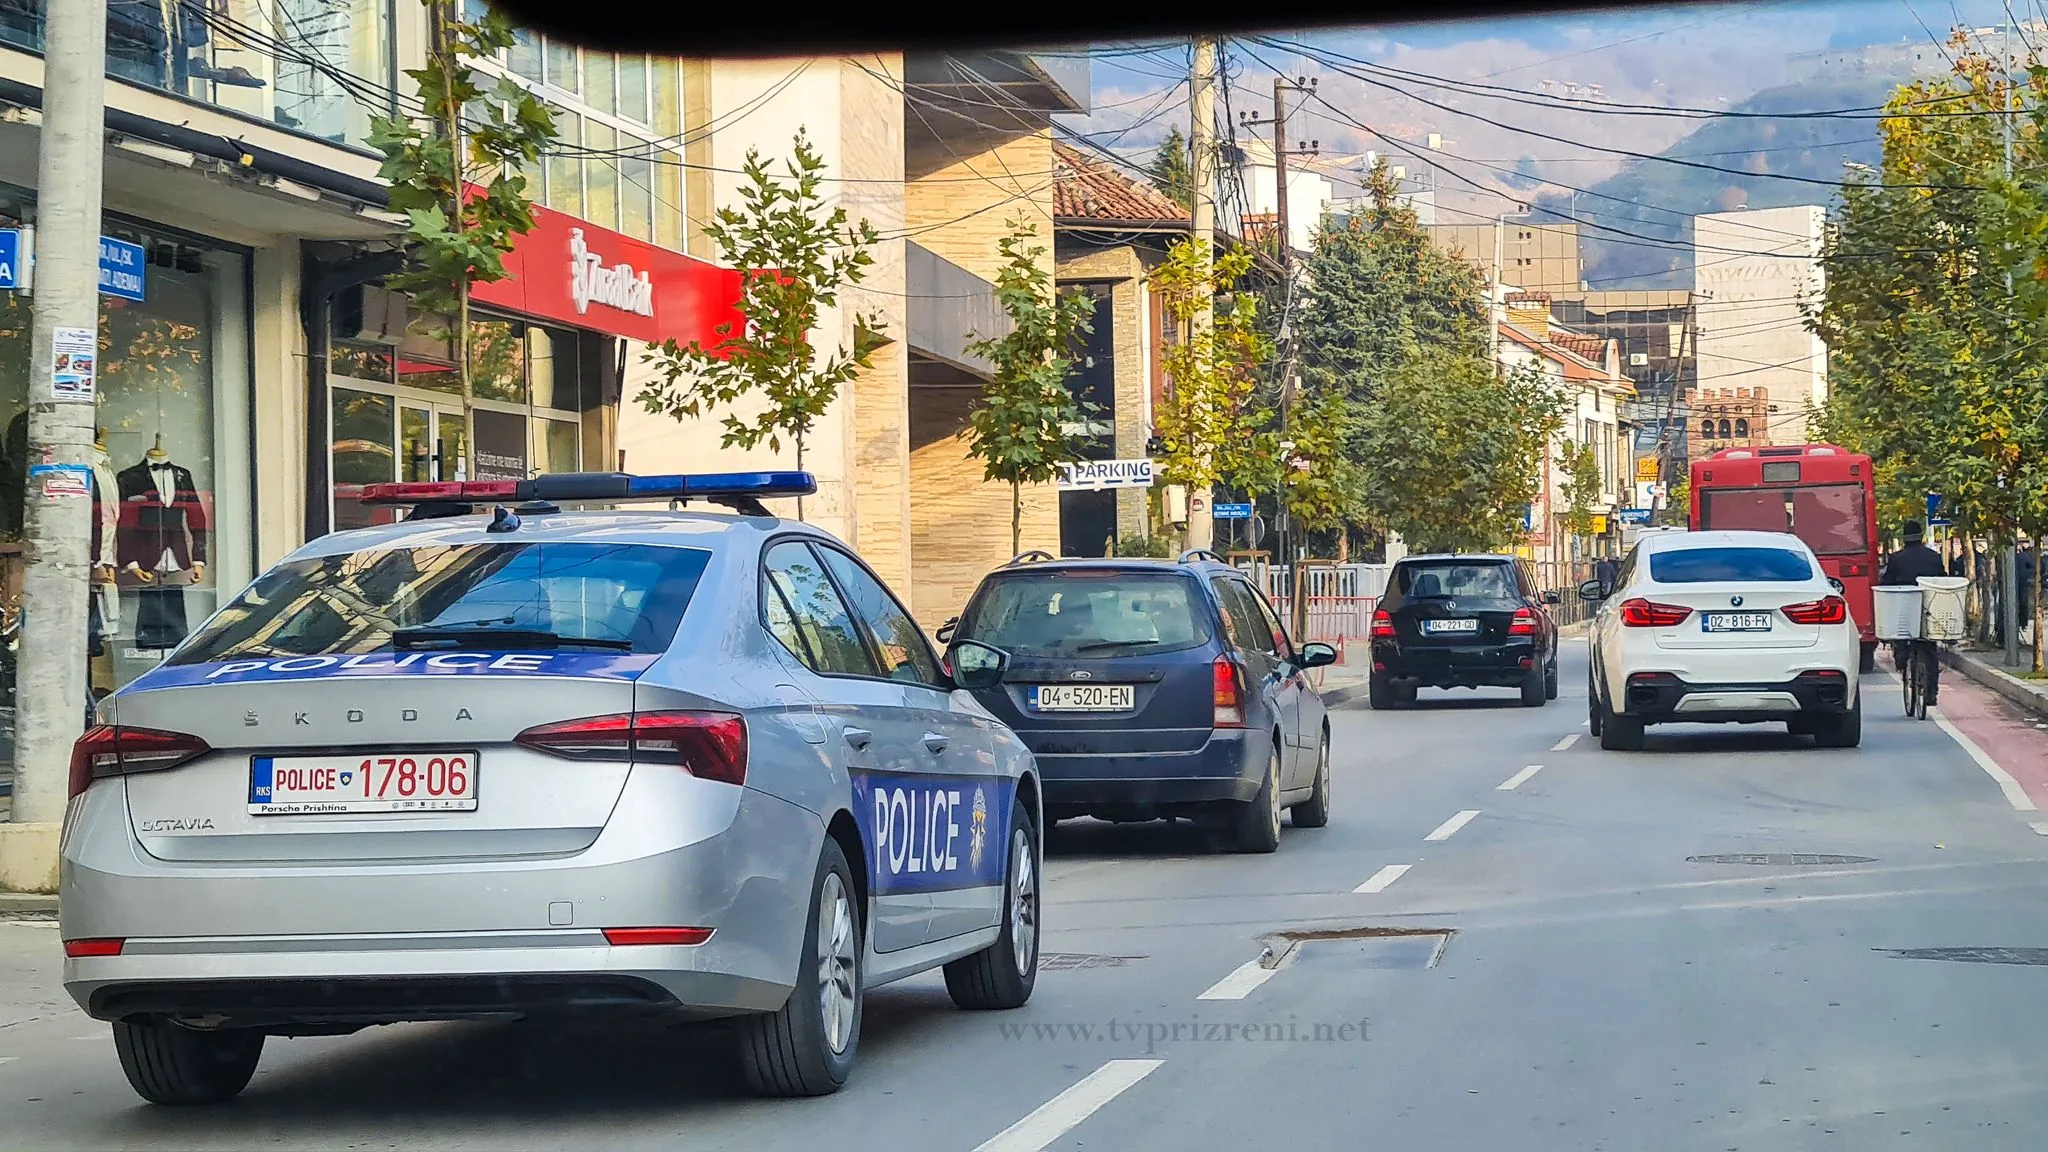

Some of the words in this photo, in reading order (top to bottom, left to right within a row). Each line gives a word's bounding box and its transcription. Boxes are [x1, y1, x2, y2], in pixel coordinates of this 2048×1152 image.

[1075, 462, 1151, 478] PARKING
[1711, 615, 1724, 628] 02
[205, 653, 554, 679] POLICE
[1042, 687, 1061, 706] 04
[1073, 687, 1129, 706] 520-EN
[276, 768, 336, 791] POLICE
[256, 785, 271, 796] RKS
[261, 804, 301, 813] Porsche
[303, 803, 347, 813] Prishtina
[142, 818, 214, 832] OCTAVIA
[874, 787, 960, 875] POLICE
